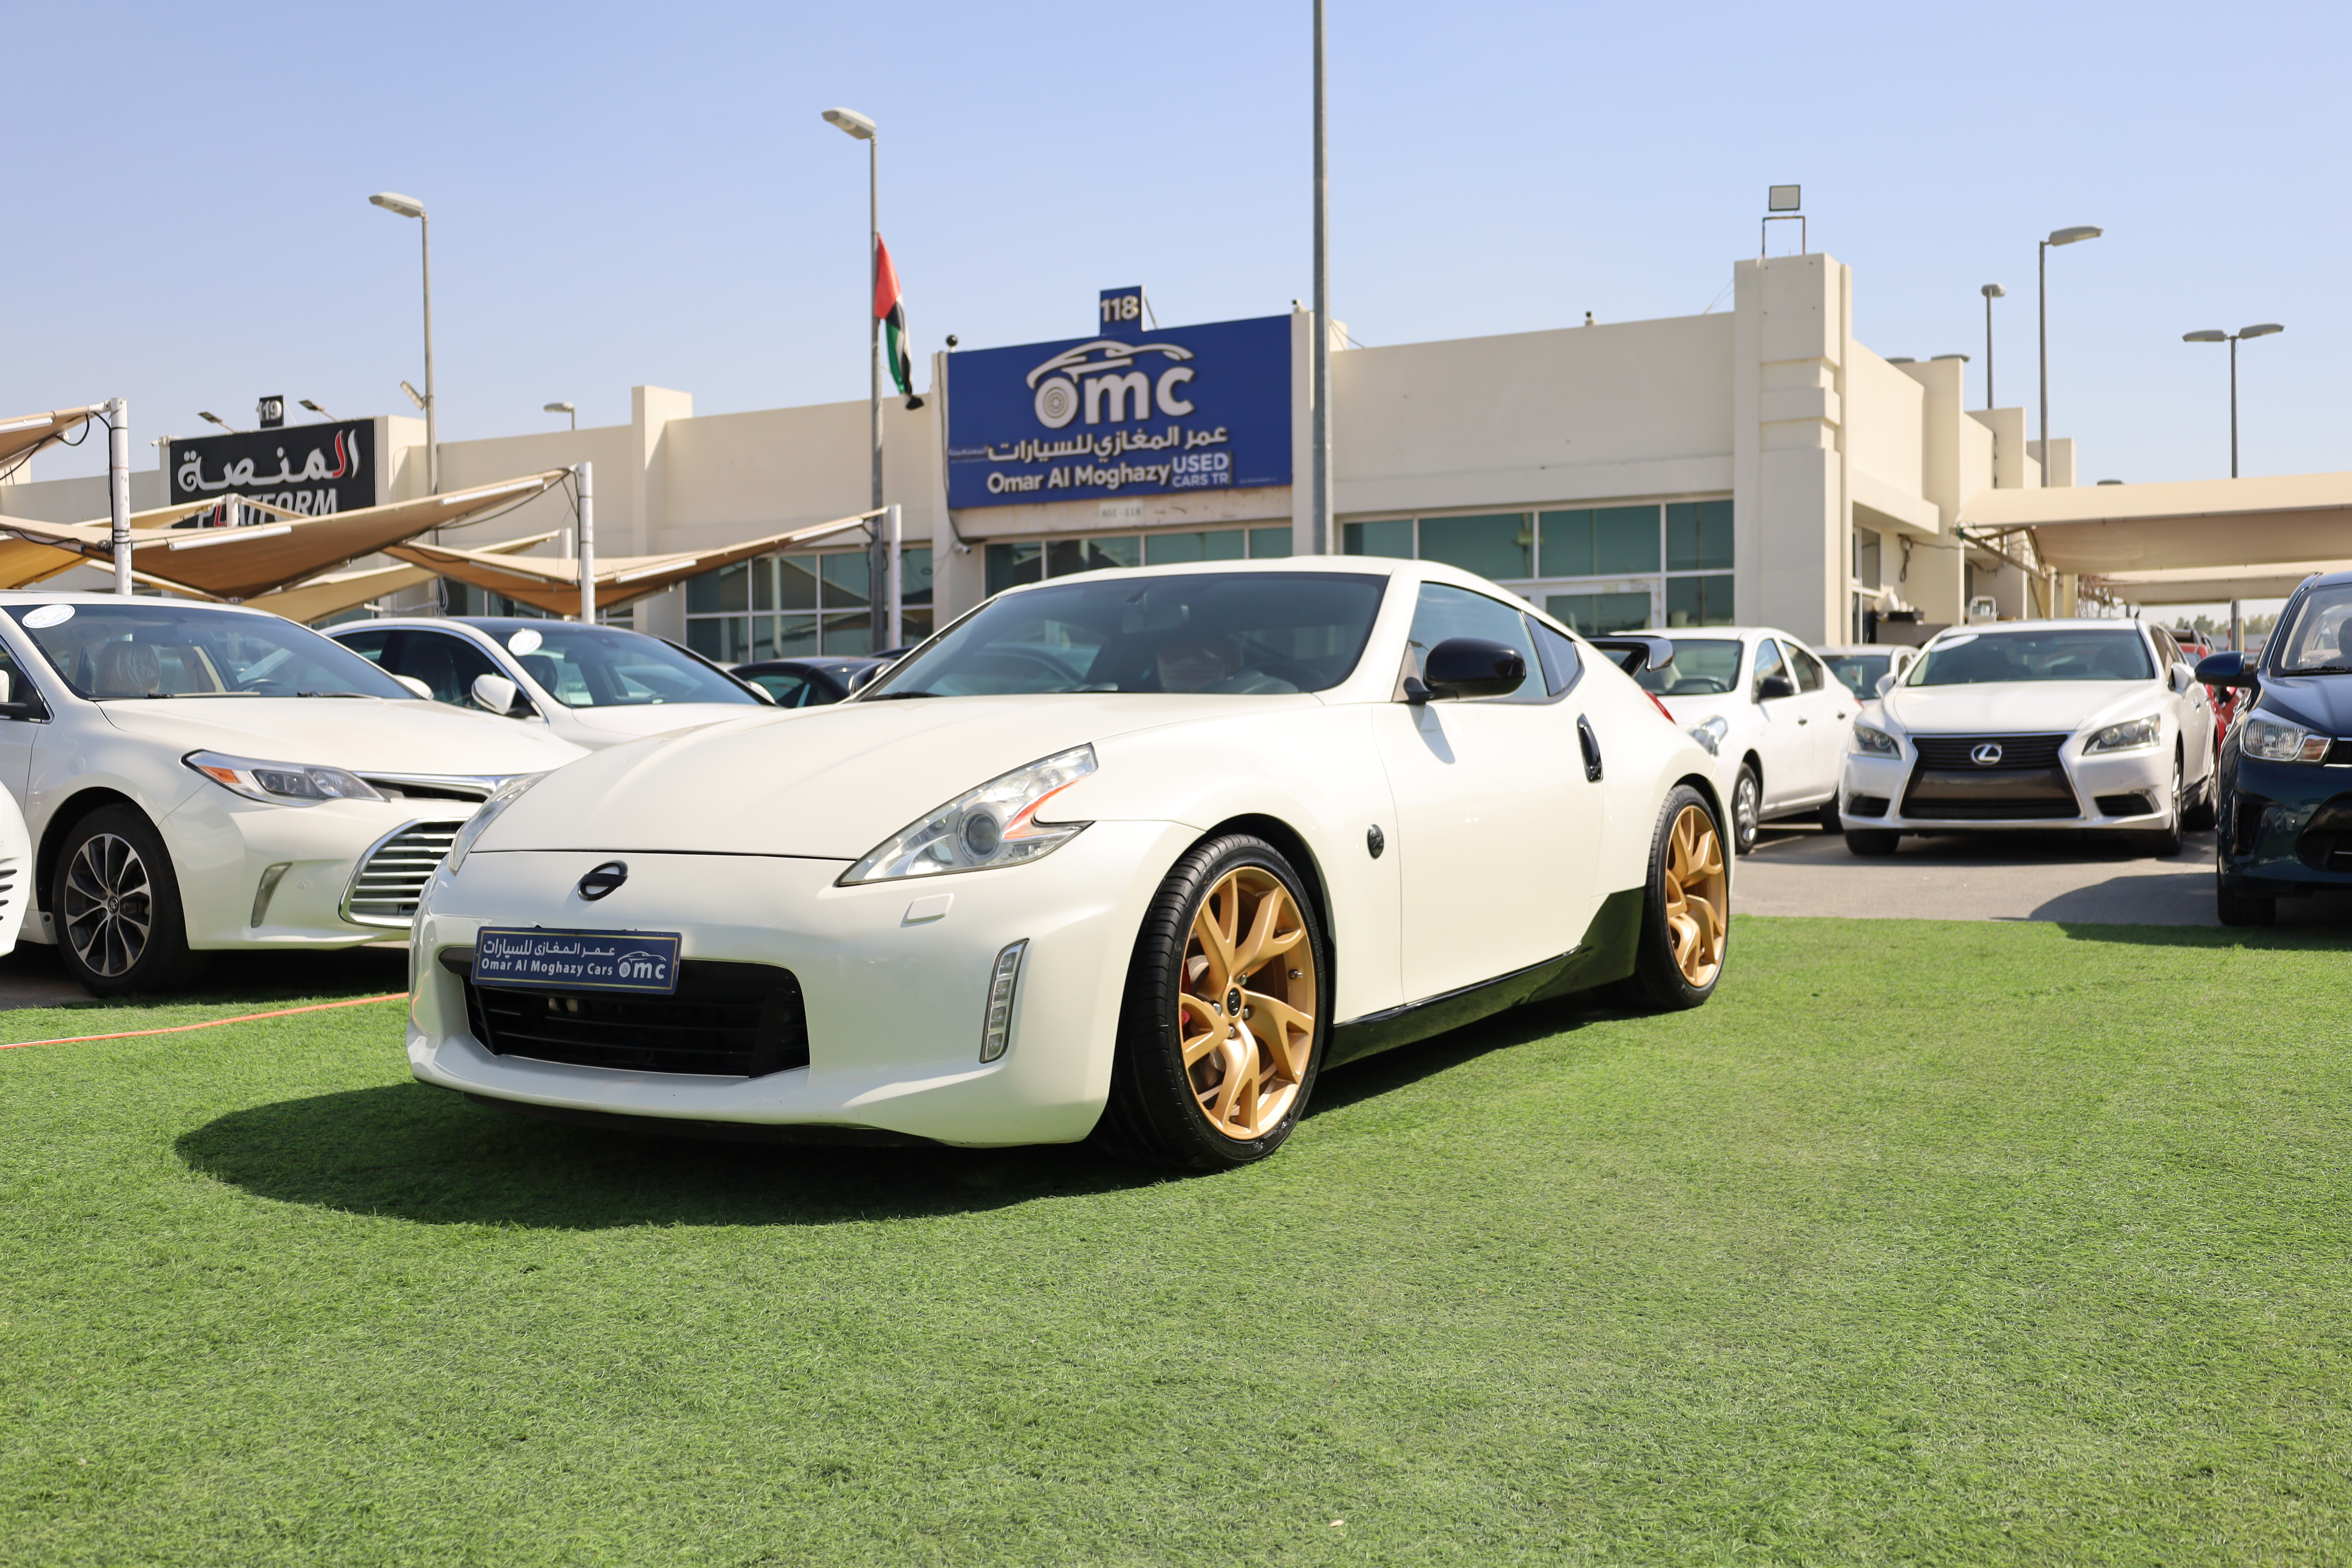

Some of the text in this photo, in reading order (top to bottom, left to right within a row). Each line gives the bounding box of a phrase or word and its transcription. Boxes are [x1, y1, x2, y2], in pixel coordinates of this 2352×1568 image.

[1101, 296, 1139, 322] 118
[1035, 366, 1194, 429] omc
[256, 400, 283, 421] 119
[988, 426, 1228, 463] عمر المغازي للسيارات
[178, 429, 361, 492] المنصة
[1172, 453, 1229, 474] USED
[987, 463, 1170, 494] Omar Al Moghazy
[1172, 473, 1208, 488] CARS
[1211, 472, 1229, 485] TR
[483, 939, 533, 959] للسيارات
[581, 946, 615, 958] عمر
[481, 958, 613, 977] Omar Al Moghazy Cars
[619, 962, 666, 979] omc
